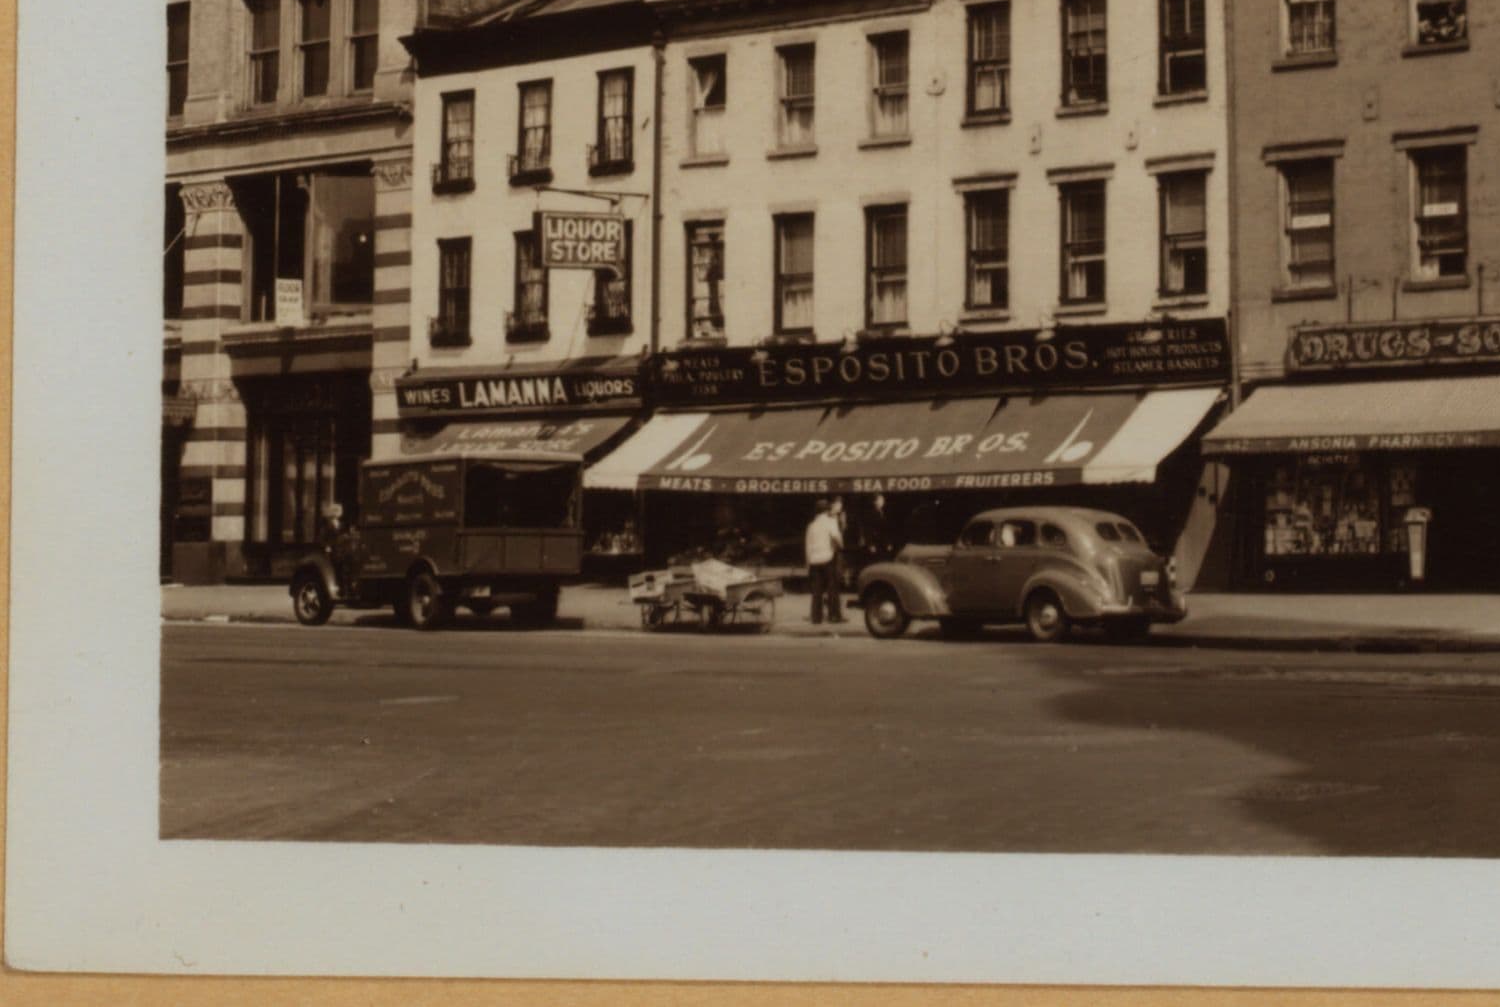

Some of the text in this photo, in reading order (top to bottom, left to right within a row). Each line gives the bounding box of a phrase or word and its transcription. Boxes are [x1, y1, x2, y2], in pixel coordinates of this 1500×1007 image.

[547, 219, 621, 240] LIQUOR
[551, 241, 616, 261] STORE
[1167, 341, 1222, 354] PRODUCTS
[759, 342, 1098, 387] ESPOSITO BROS.
[404, 377, 634, 408] WINES LAMANNA LIQUORS
[1288, 437, 1356, 451] ANSONIA
[1369, 433, 1456, 449] PHARMACY
[660, 471, 1054, 493] MEATS GROCERIES SEA FOOD FRUITERERS
